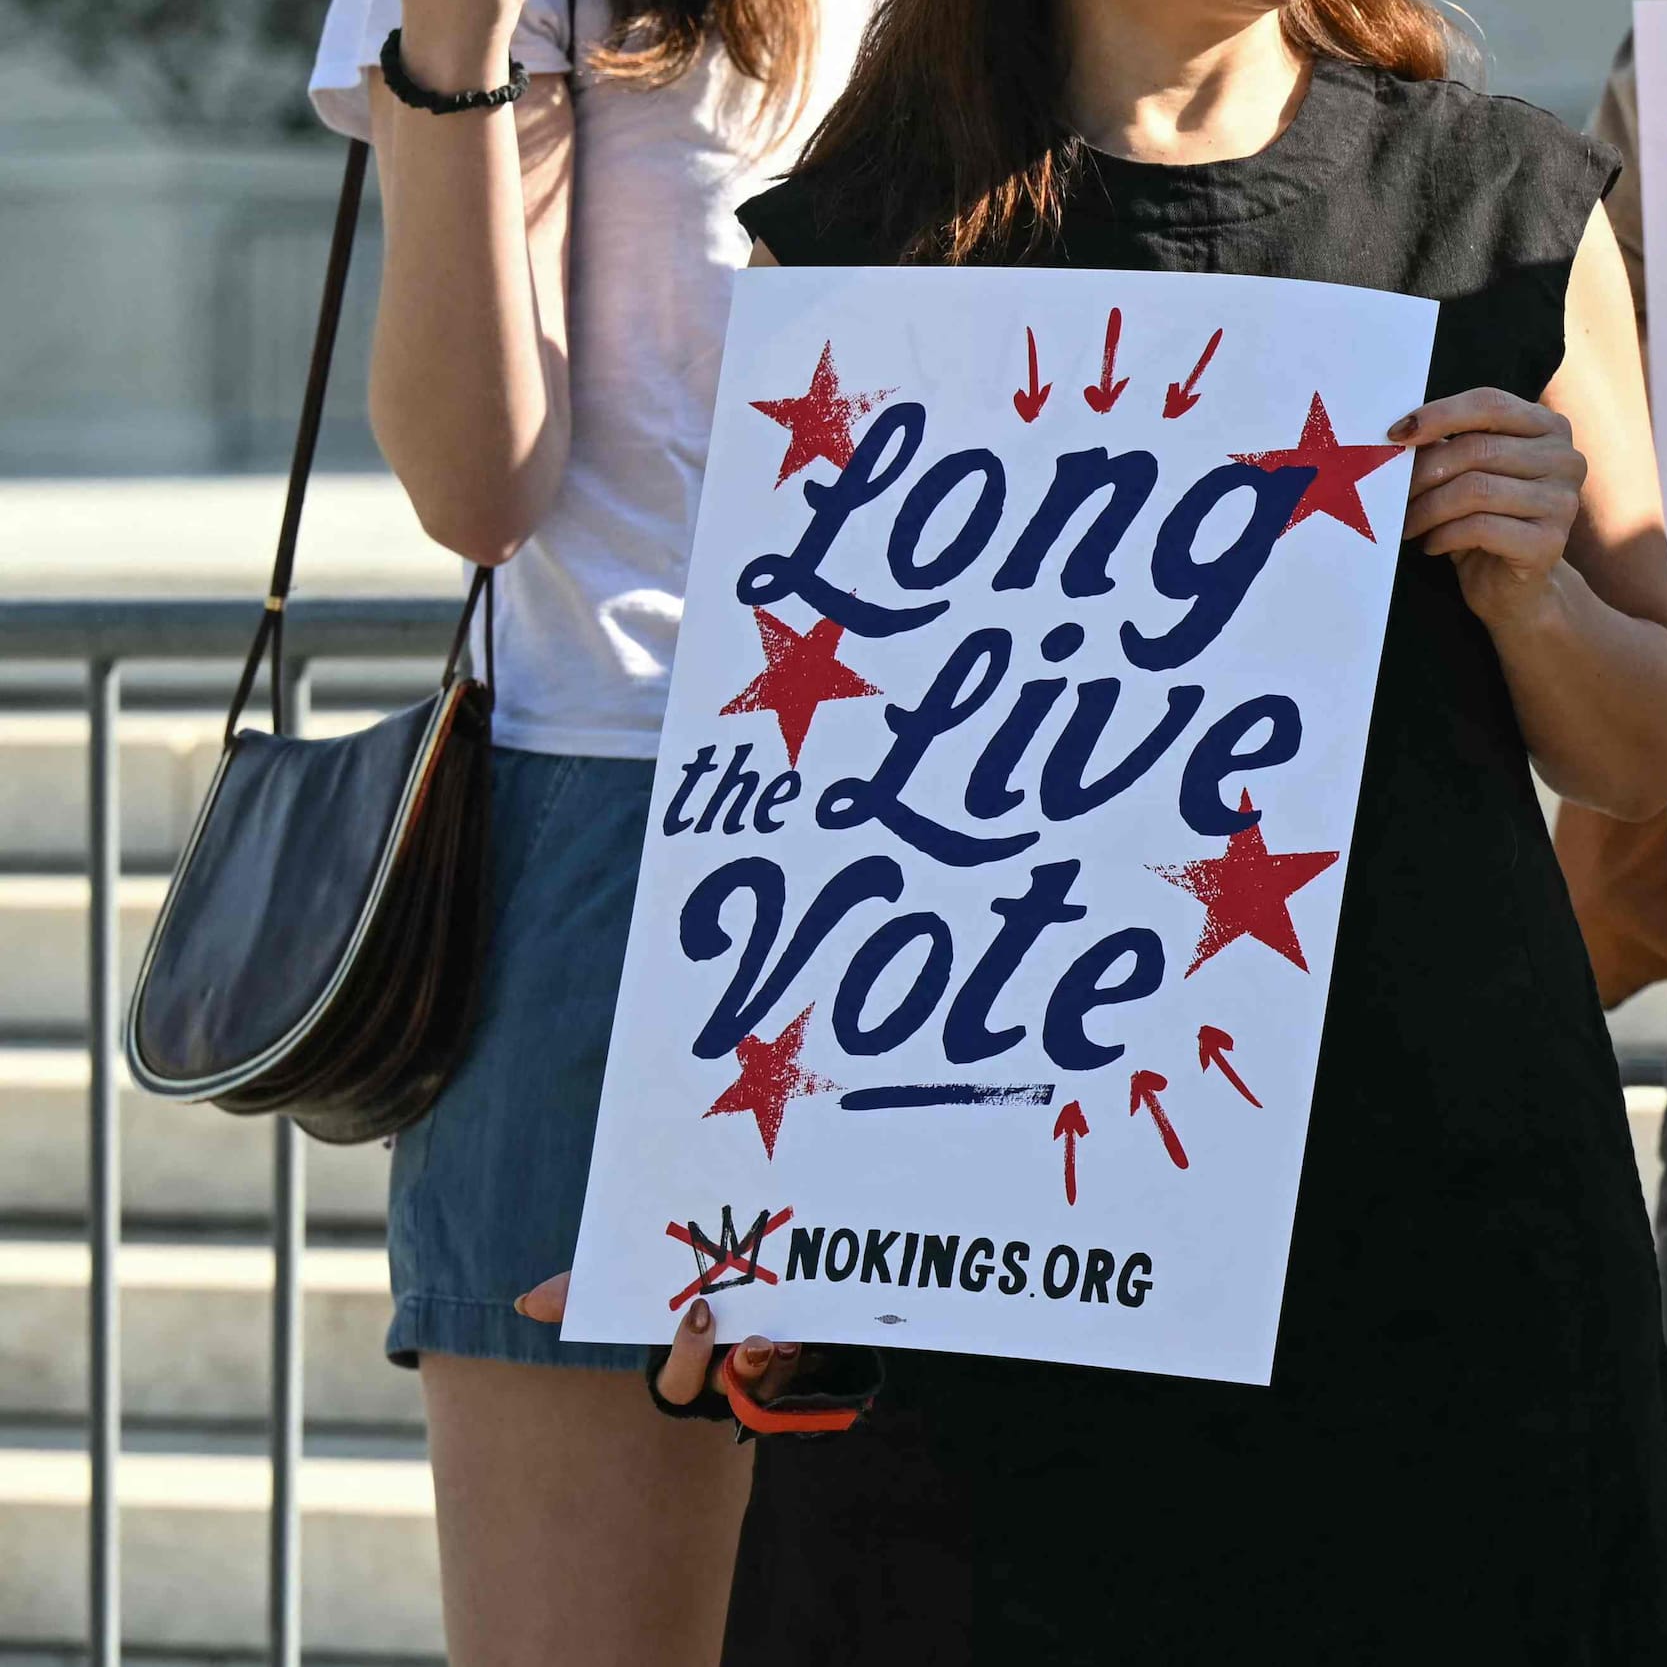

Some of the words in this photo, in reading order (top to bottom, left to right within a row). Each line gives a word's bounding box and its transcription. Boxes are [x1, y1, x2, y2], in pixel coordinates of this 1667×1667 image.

[736, 402, 1319, 672] Long
[662, 742, 802, 837] the
[815, 622, 1303, 867] Live
[679, 855, 1166, 1071] Vote
[785, 1227, 1154, 1308] NOKINGS.ORG
